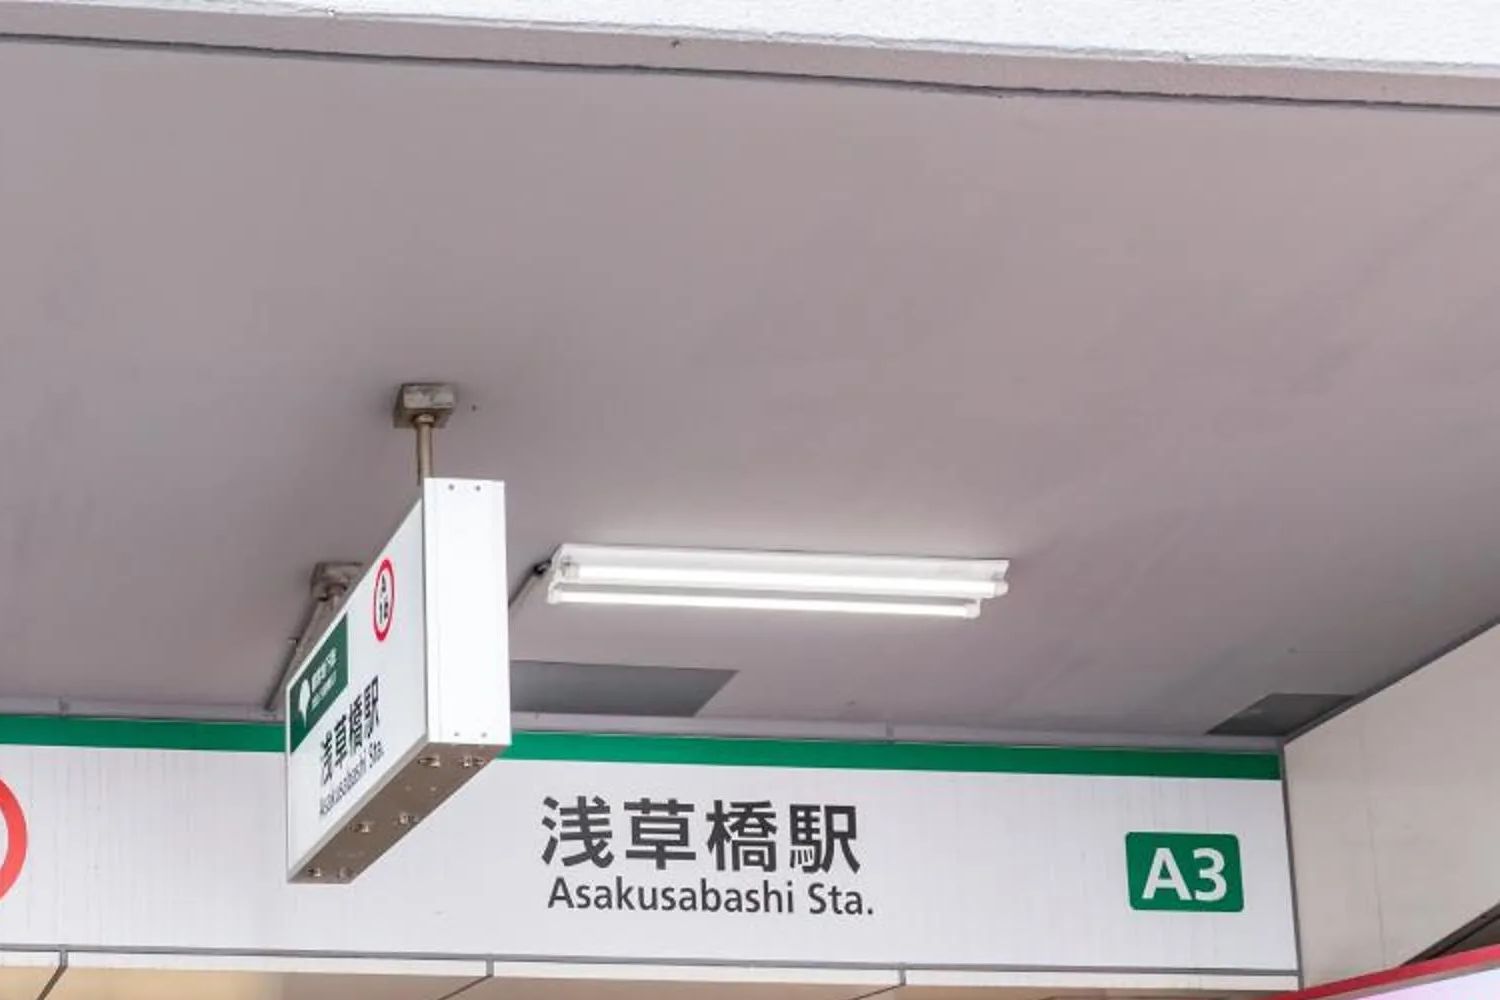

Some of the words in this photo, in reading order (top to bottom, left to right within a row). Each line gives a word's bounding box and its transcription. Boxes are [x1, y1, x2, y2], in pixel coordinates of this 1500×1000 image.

[320, 674, 380, 787] 浅草橋駅
[540, 794, 861, 875] 浅草橋駅
[547, 875, 795, 915] Asakusabashi
[807, 881, 875, 917] Sta.
[1142, 847, 1227, 902] A3
